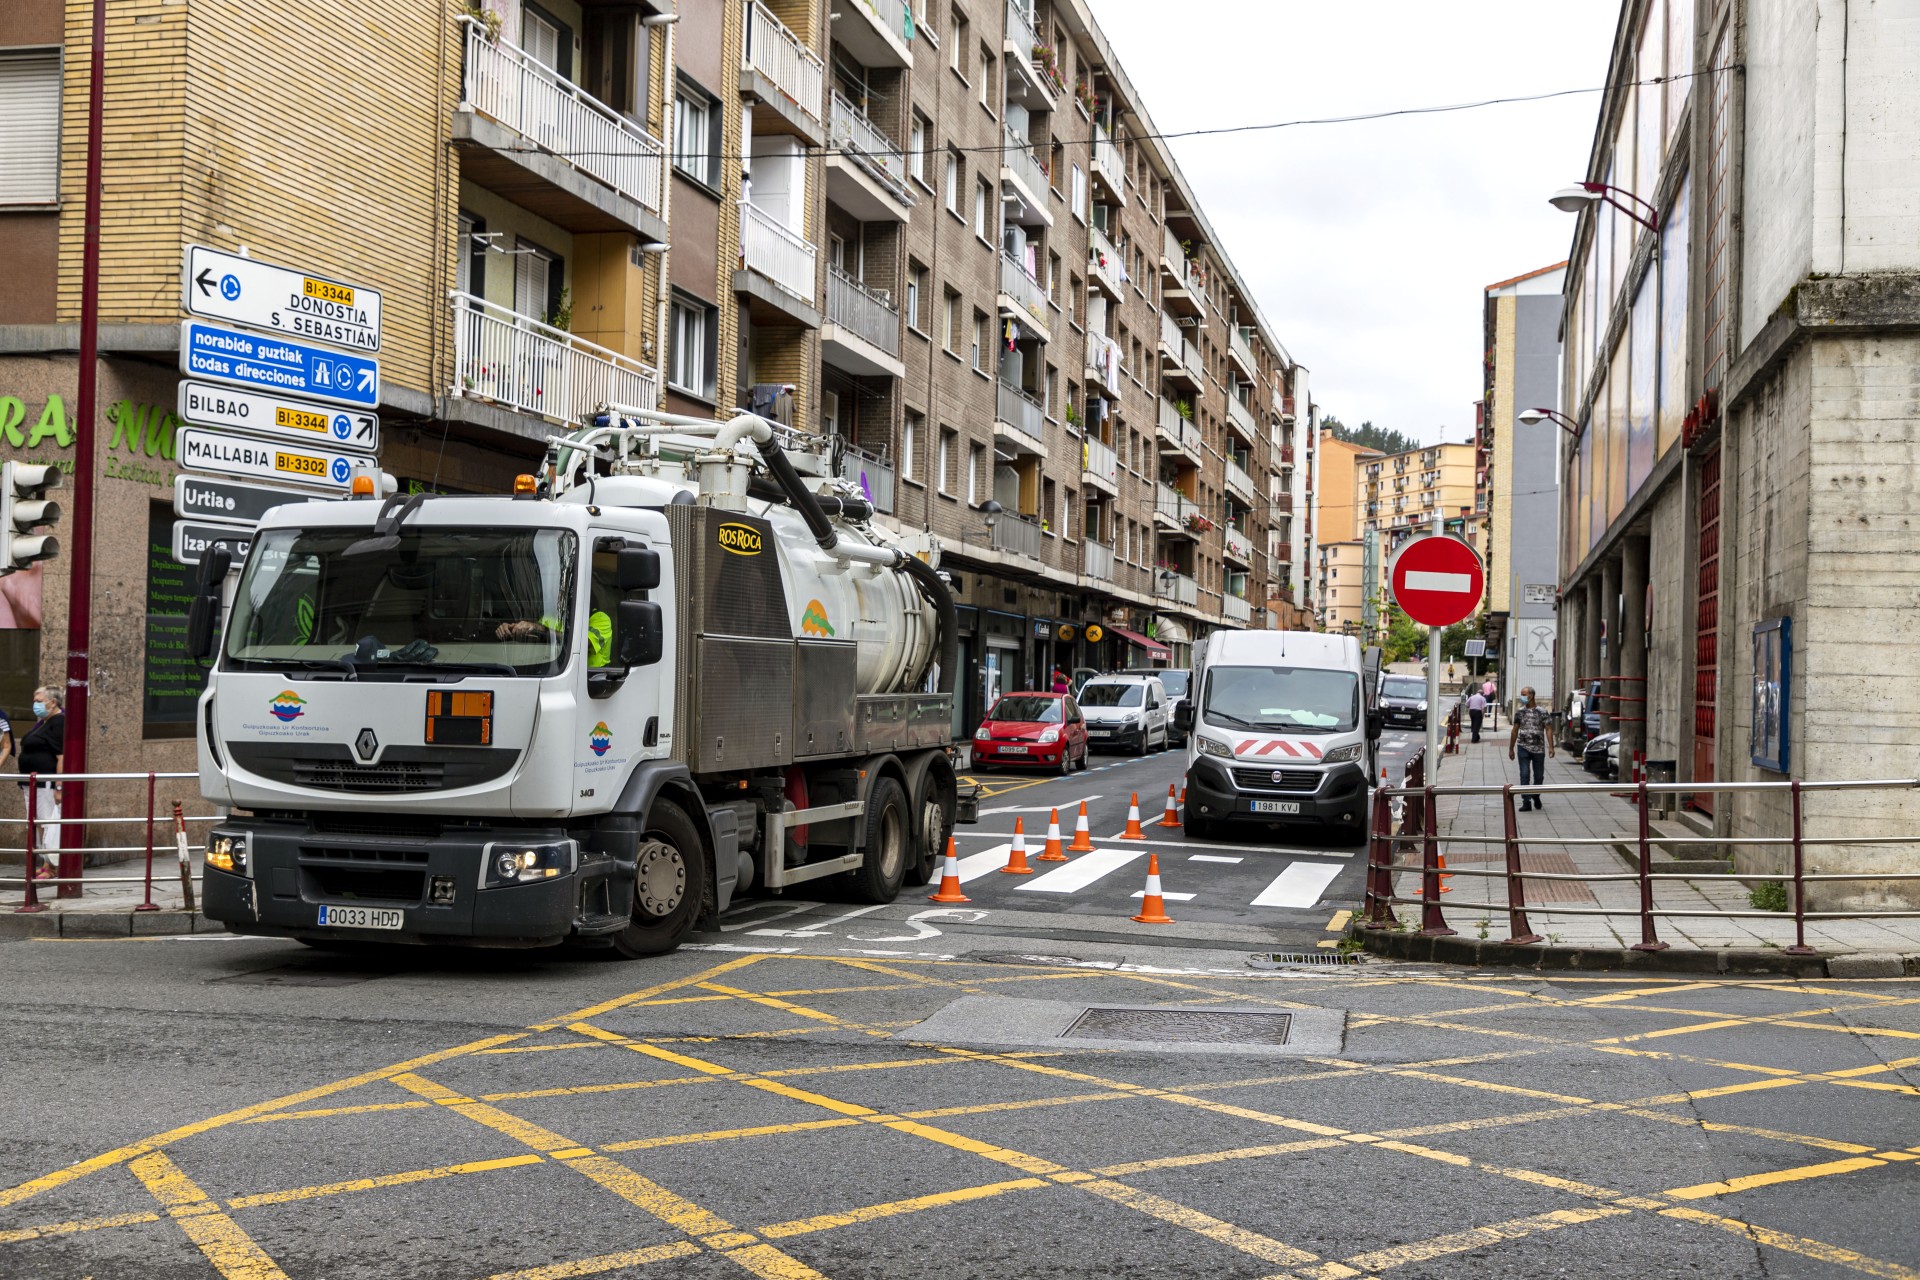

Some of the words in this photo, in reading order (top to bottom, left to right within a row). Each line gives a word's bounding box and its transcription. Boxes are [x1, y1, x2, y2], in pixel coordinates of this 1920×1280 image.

[305, 281, 353, 303] BI-3344
[290, 294, 368, 325] DONOSTIA
[271, 312, 286, 328] S.
[293, 317, 377, 349] SEBASTIÁN
[195, 332, 253, 354] norabide
[257, 345, 303, 365] guztiak
[191, 354, 230, 374] todas
[234, 362, 306, 388] direcciones
[189, 395, 250, 418] BILBAO
[278, 410, 326, 430] BI-3344
[187, 441, 269, 467] MALLABIA
[278, 455, 325, 474] BI-3302
[185, 487, 224, 510] Urtia
[1258, 802, 1278, 812] 1981
[1281, 803, 1298, 813] KVJ
[329, 908, 366, 926] 0033
[371, 911, 400, 927] HDD
